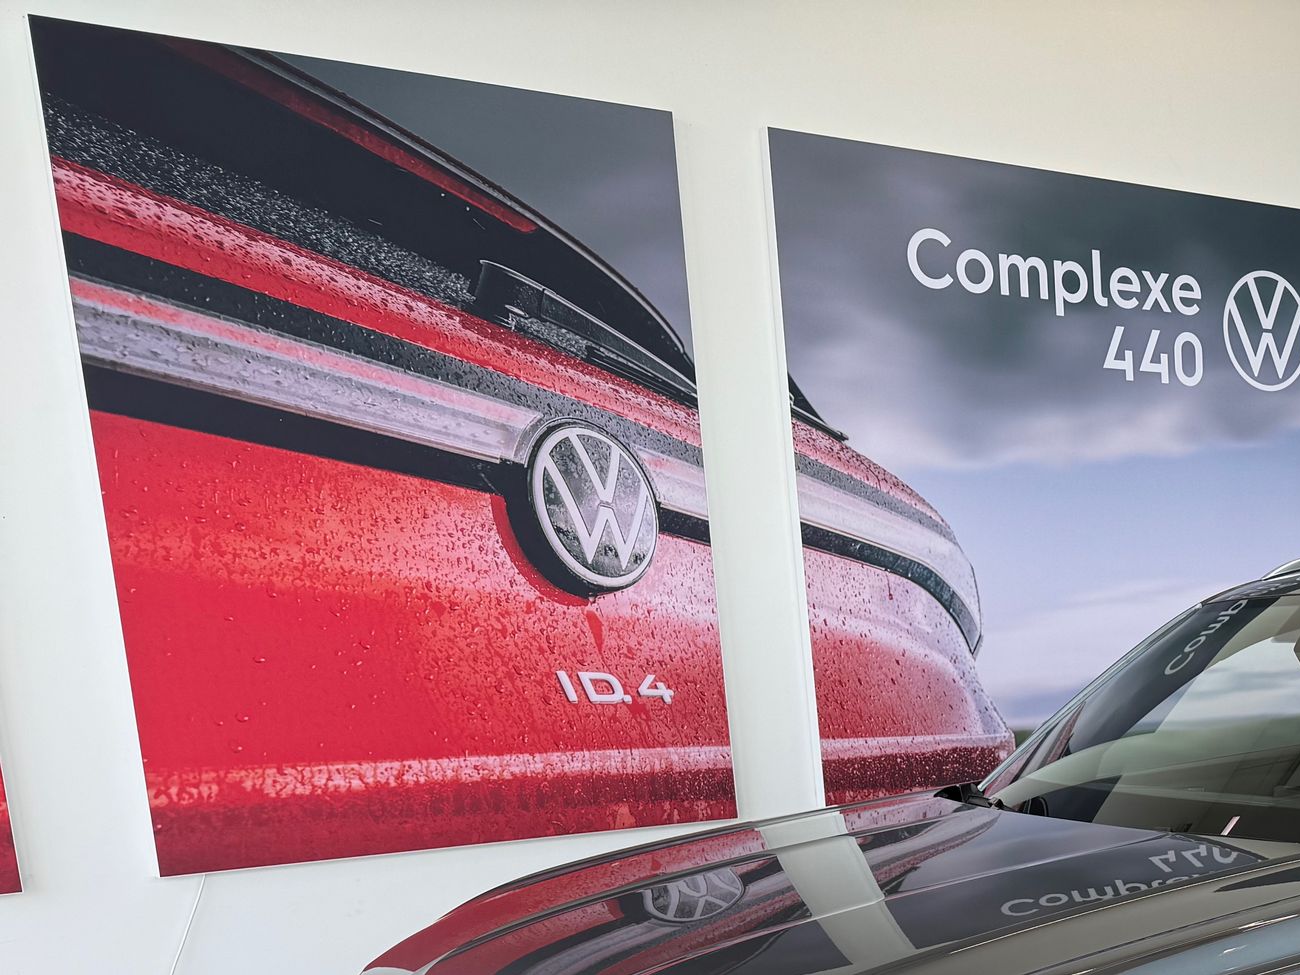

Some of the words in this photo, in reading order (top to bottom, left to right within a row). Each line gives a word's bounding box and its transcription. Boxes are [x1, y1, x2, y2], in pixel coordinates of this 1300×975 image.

[906, 227, 1203, 317] Complexe
[1102, 325, 1205, 387] 440
[556, 669, 675, 705] ID.4
